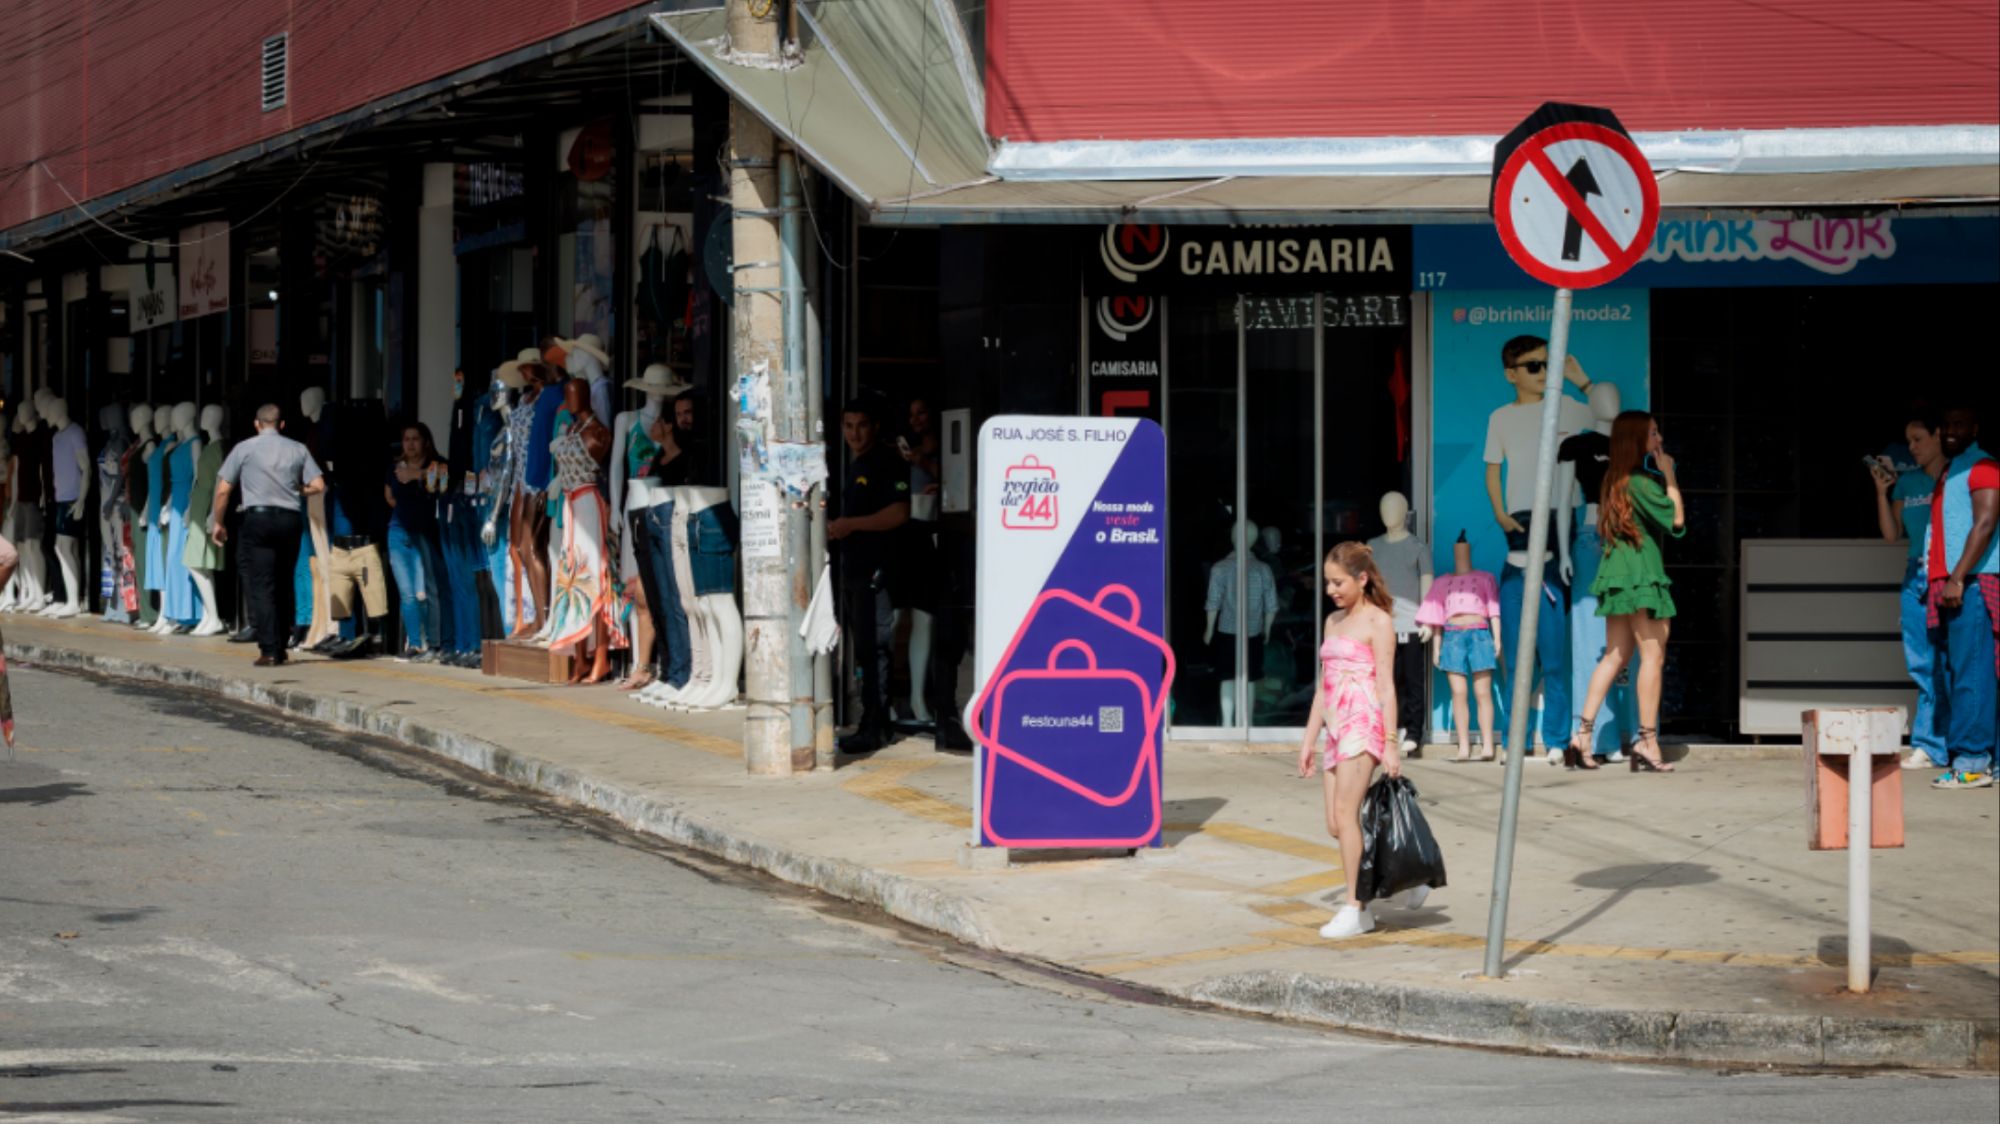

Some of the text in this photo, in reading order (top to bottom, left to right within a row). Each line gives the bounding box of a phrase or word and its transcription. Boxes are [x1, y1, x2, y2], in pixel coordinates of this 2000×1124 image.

[1652, 219, 1758, 254] rink
[1179, 237, 1394, 276] CAMISARIA
[1468, 304, 1632, 325] @brinklinmoda2
[1091, 360, 1159, 377] CAMISARIA
[992, 425, 1127, 442] RUA JOSÉ S. FILHO
[1002, 477, 1060, 499] região
[1018, 495, 1052, 520] 44
[1092, 500, 1154, 513] Nossa moda
[1105, 512, 1140, 525] veste
[1095, 528, 1160, 543] o Brasil.
[1021, 714, 1093, 727] #estouna44
